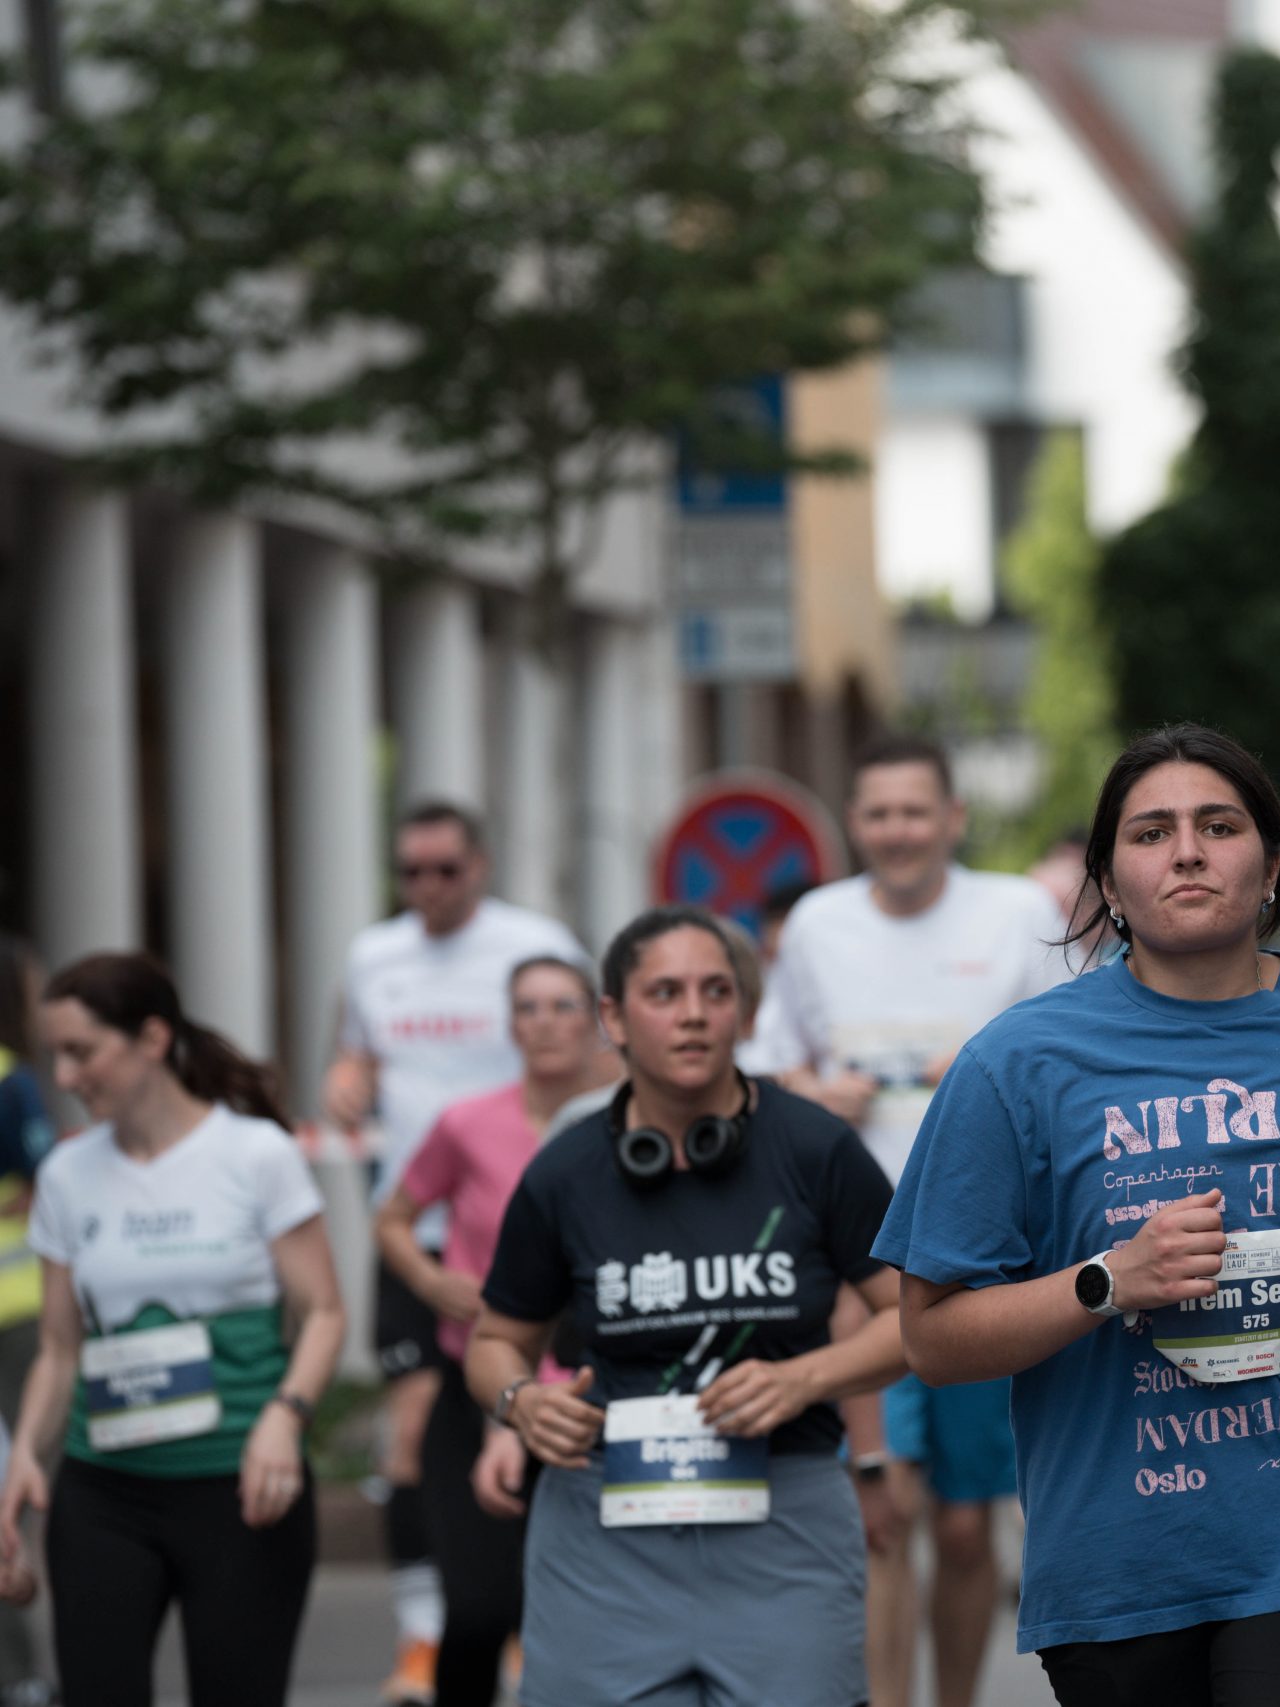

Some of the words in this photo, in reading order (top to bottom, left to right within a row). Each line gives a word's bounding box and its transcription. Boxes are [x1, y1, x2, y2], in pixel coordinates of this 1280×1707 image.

[1103, 1163, 1223, 1201] Copenhagen
[1226, 1252, 1247, 1260] FIRMEN
[1226, 1260, 1247, 1269] LAUF
[694, 1250, 797, 1301] UKS
[1242, 1313, 1270, 1330] 575
[1182, 1356, 1197, 1365] dm
[1255, 1352, 1275, 1361] BOSCH
[1134, 1463, 1207, 1496] Oslo
